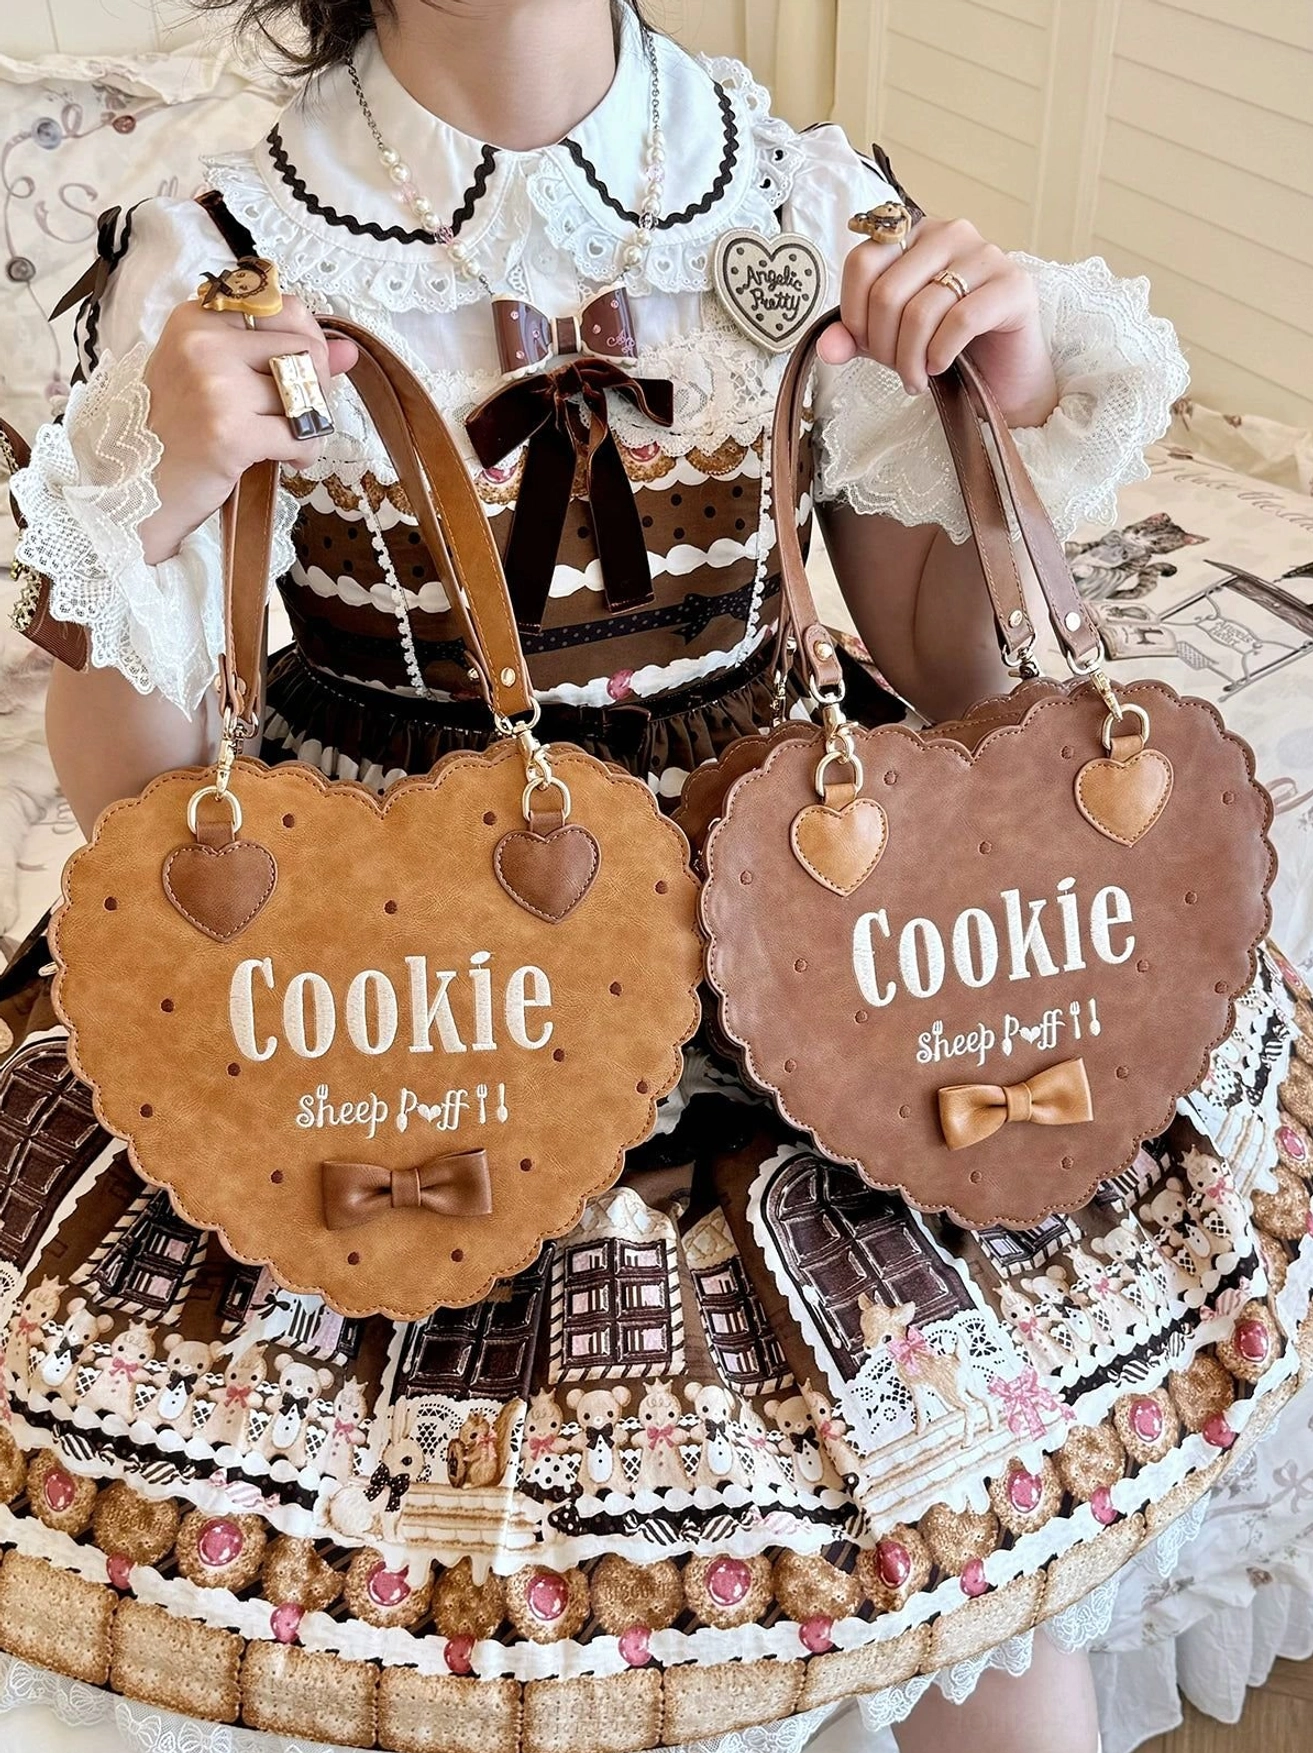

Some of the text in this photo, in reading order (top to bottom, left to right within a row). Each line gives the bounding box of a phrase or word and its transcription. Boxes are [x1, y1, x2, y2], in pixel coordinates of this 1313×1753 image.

[742, 265, 803, 292] Angelic
[749, 287, 801, 322] Pretty
[852, 876, 1136, 1007] Cookie
[229, 950, 554, 1062] Cookie
[916, 1019, 996, 1067] Sheep
[295, 1083, 389, 1140] Sheep
